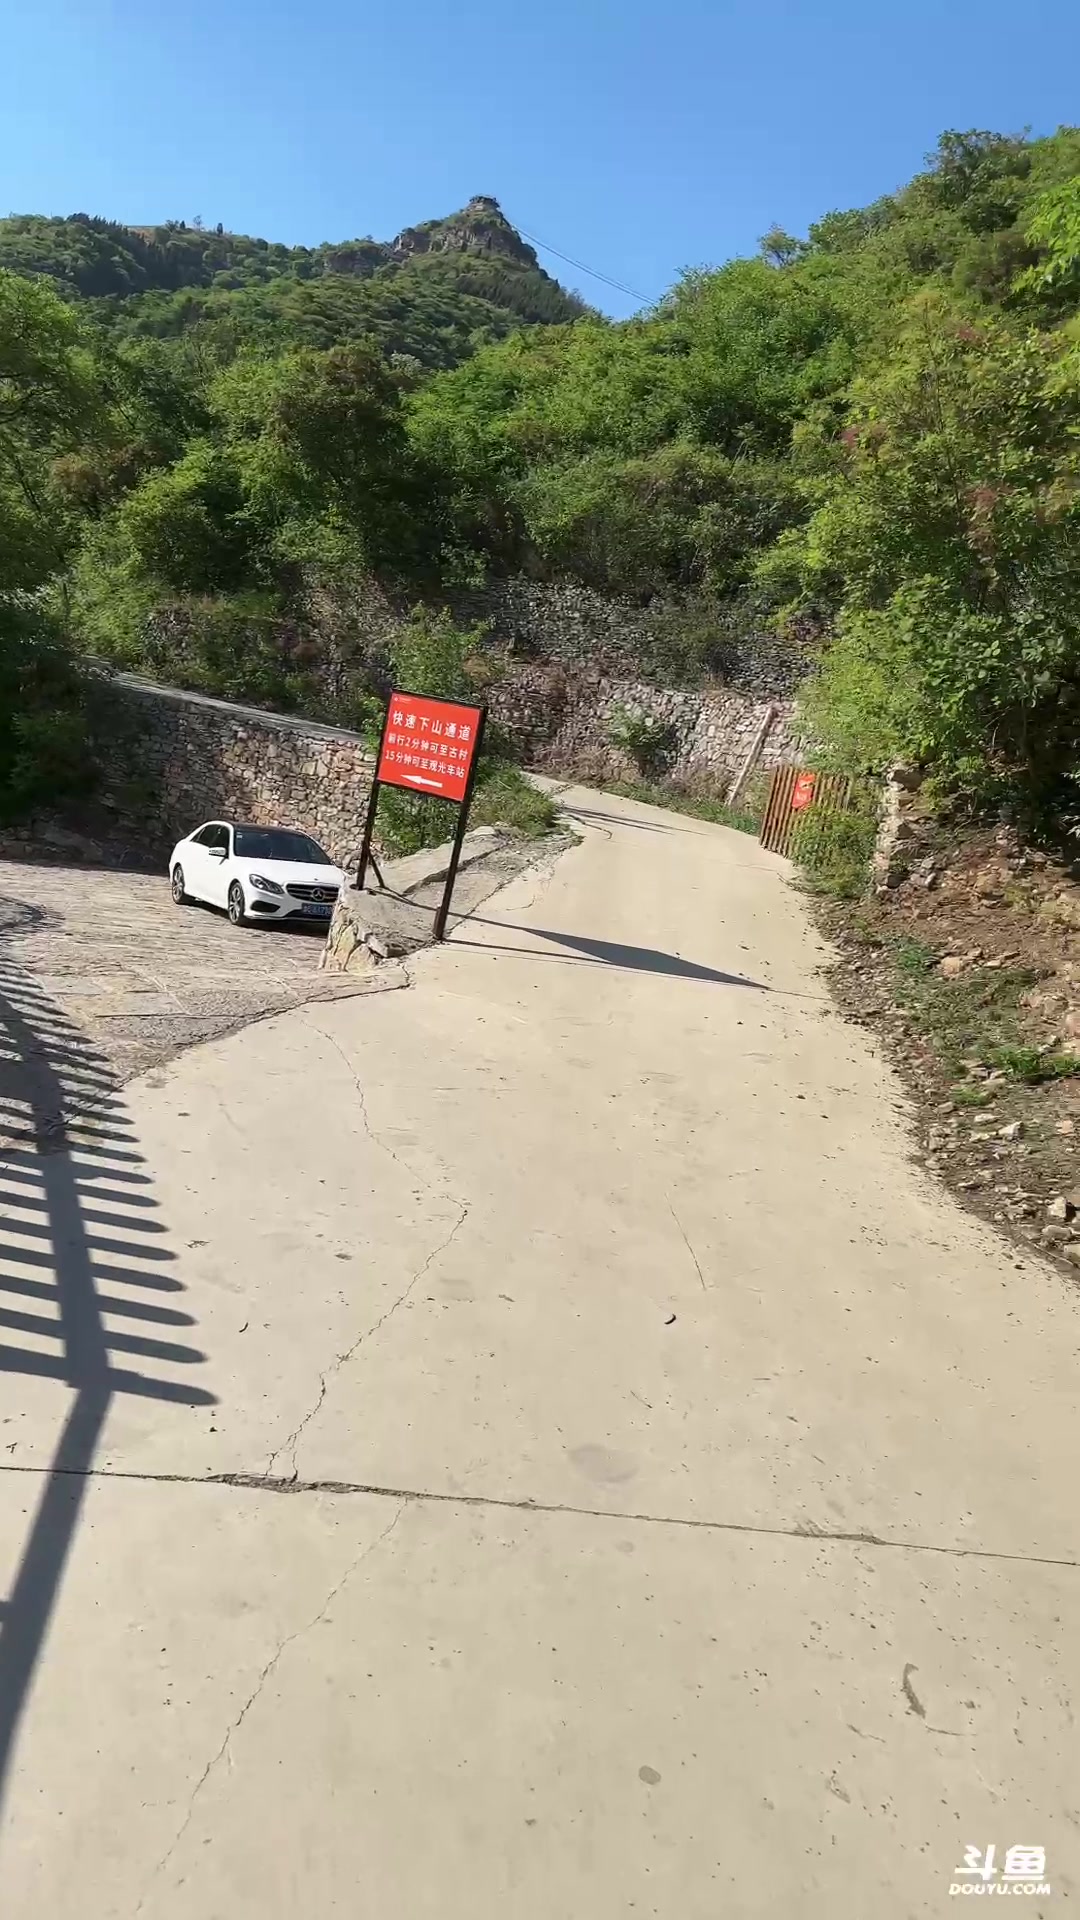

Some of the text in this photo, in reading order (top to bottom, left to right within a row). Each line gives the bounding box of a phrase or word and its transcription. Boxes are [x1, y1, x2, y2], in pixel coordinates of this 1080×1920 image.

[392, 711, 471, 741] 快速下山通道
[384, 750, 466, 778] 15分钟可至观光车站
